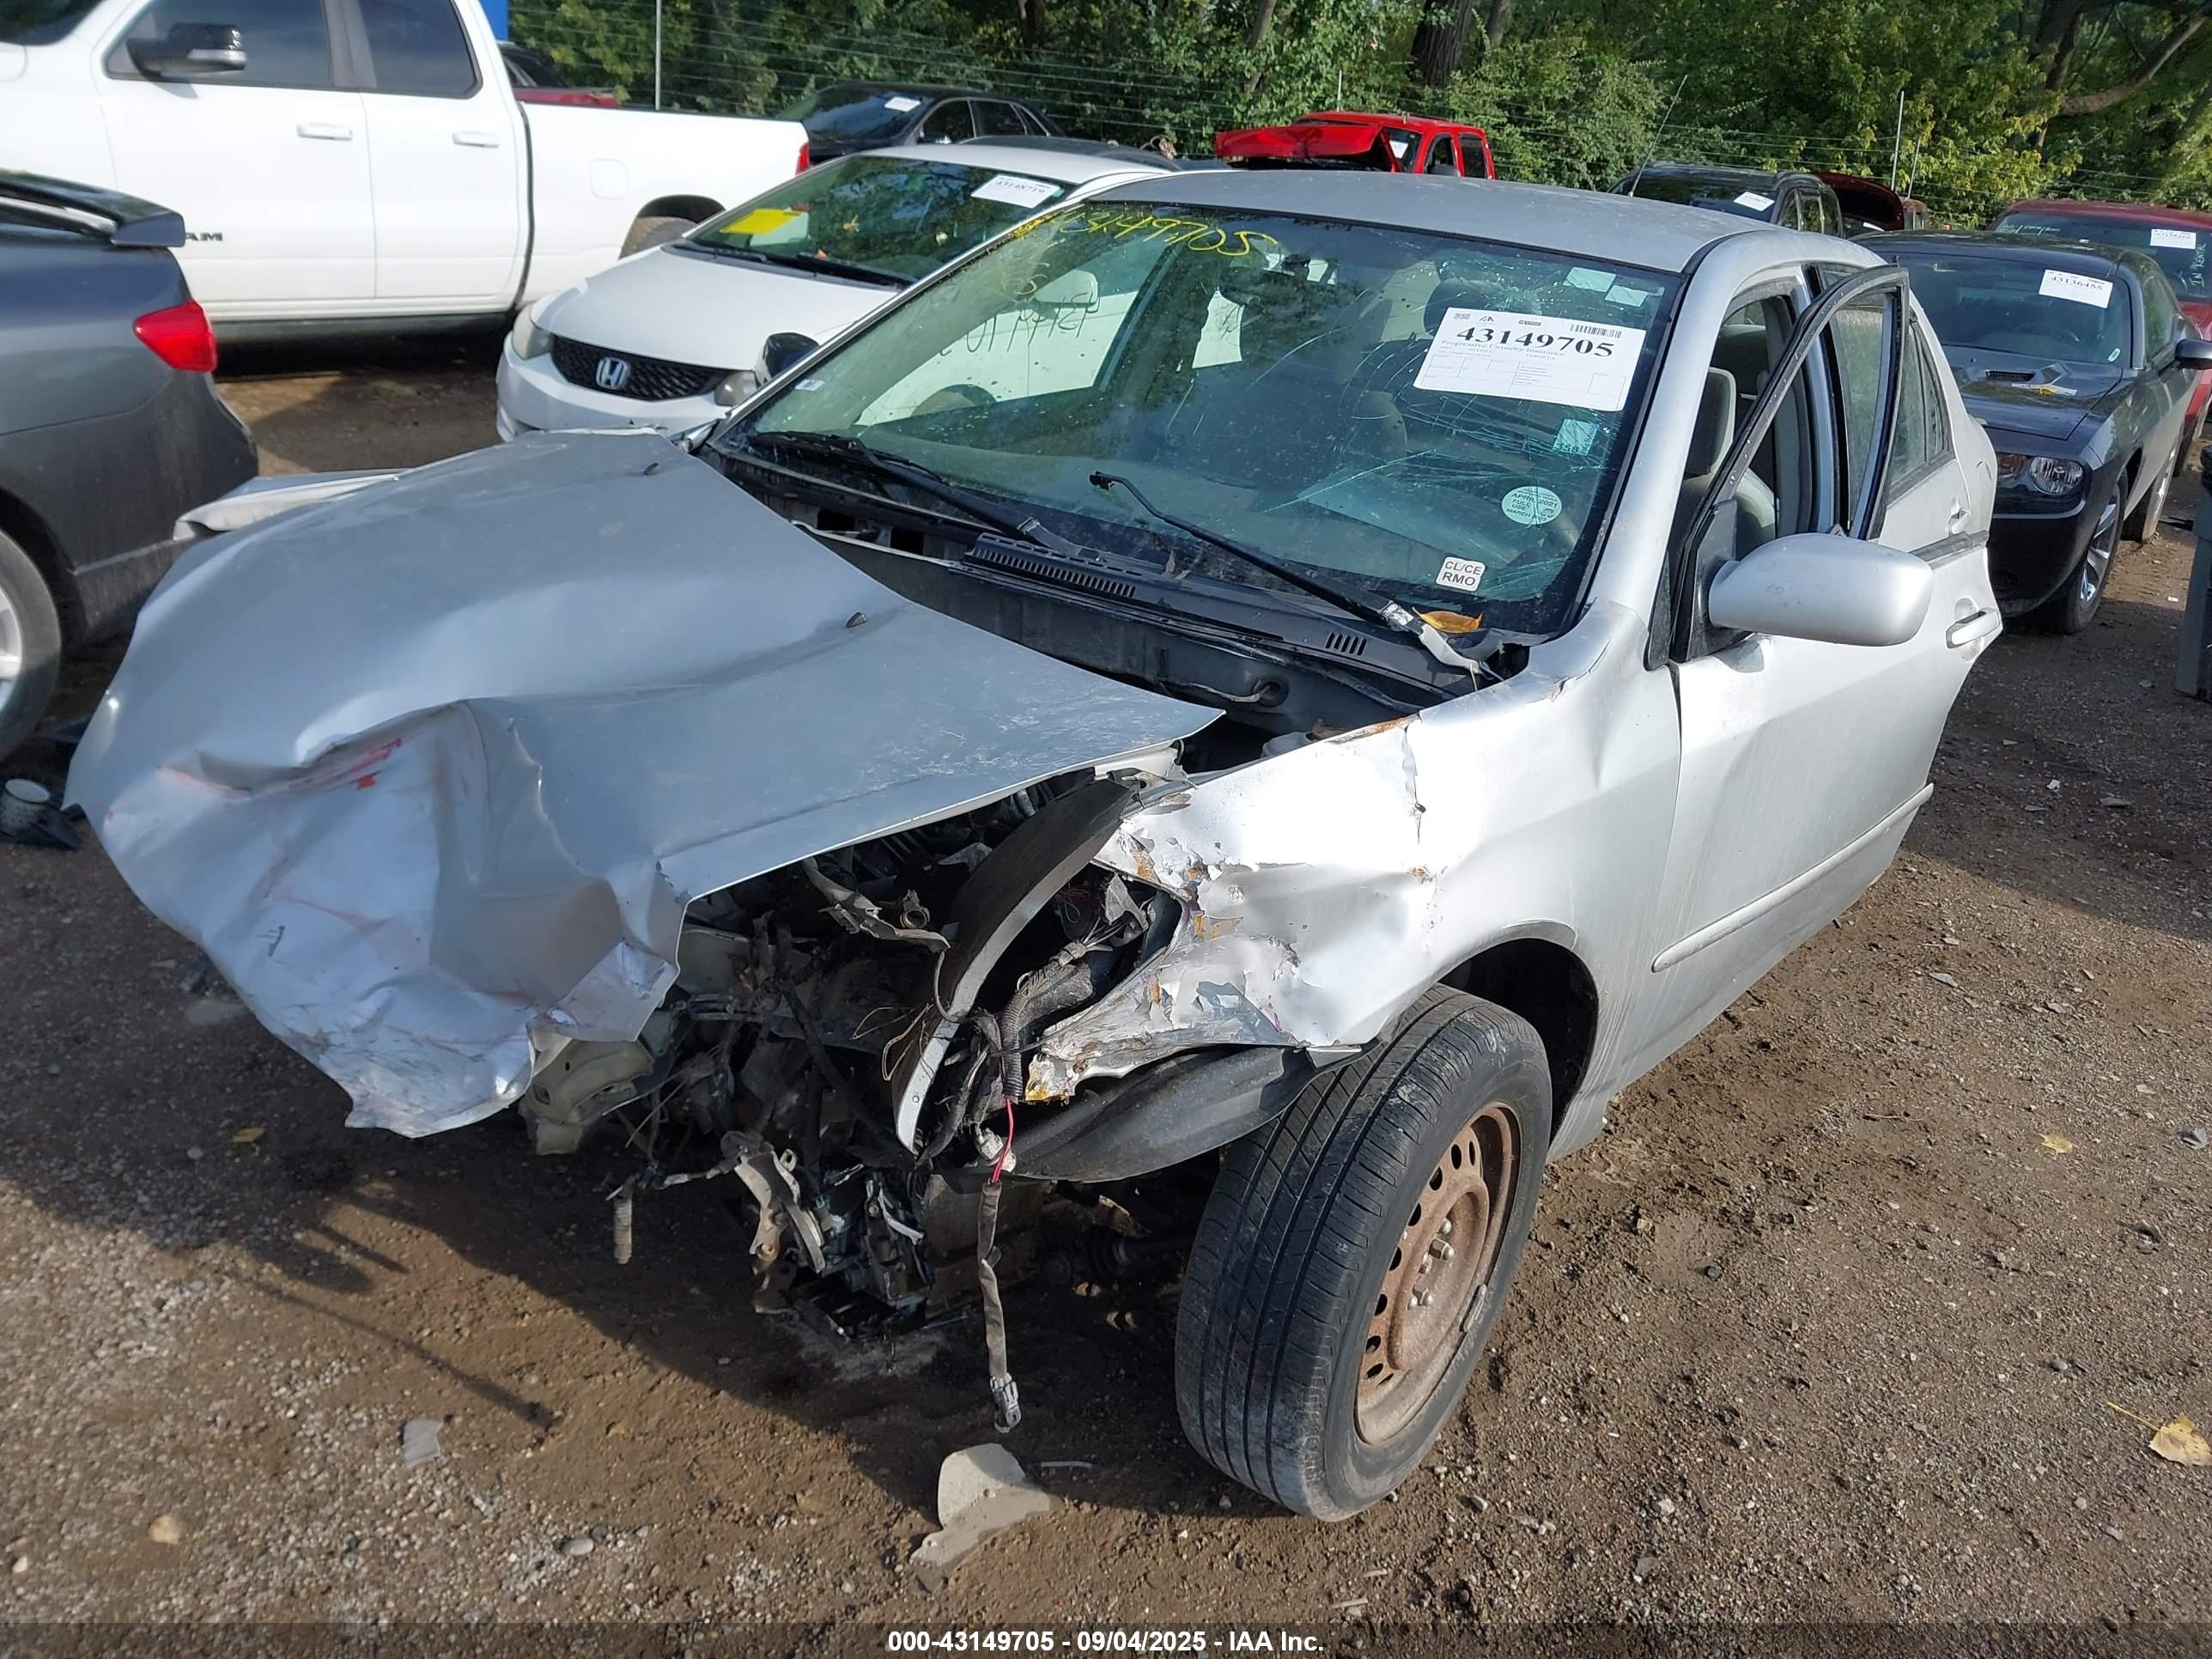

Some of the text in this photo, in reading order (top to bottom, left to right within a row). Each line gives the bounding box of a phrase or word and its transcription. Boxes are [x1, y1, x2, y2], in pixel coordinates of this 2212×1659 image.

[185, 232, 223, 241] AM
[1456, 326, 1615, 357] 43149705
[1511, 493, 1535, 502] APRIL
[1538, 499, 1558, 508] 2021
[1506, 507, 1531, 518] MARCH
[1444, 561, 1483, 575] CL/CE
[1442, 571, 1476, 586] RMO
